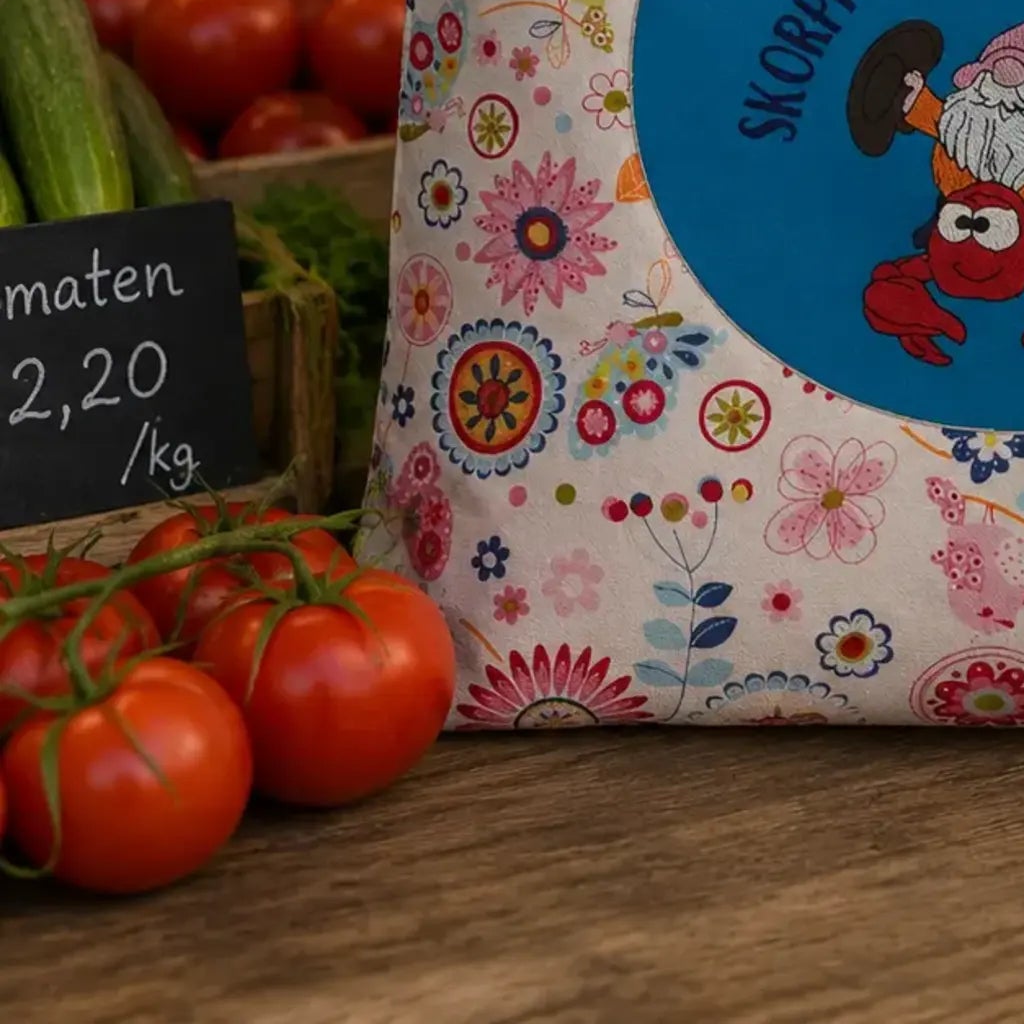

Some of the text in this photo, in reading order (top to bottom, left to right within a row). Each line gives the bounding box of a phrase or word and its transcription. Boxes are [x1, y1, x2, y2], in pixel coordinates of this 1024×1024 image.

[0, 247, 184, 320] maten
[9, 341, 167, 431] 2,20
[121, 420, 201, 491] /kg
